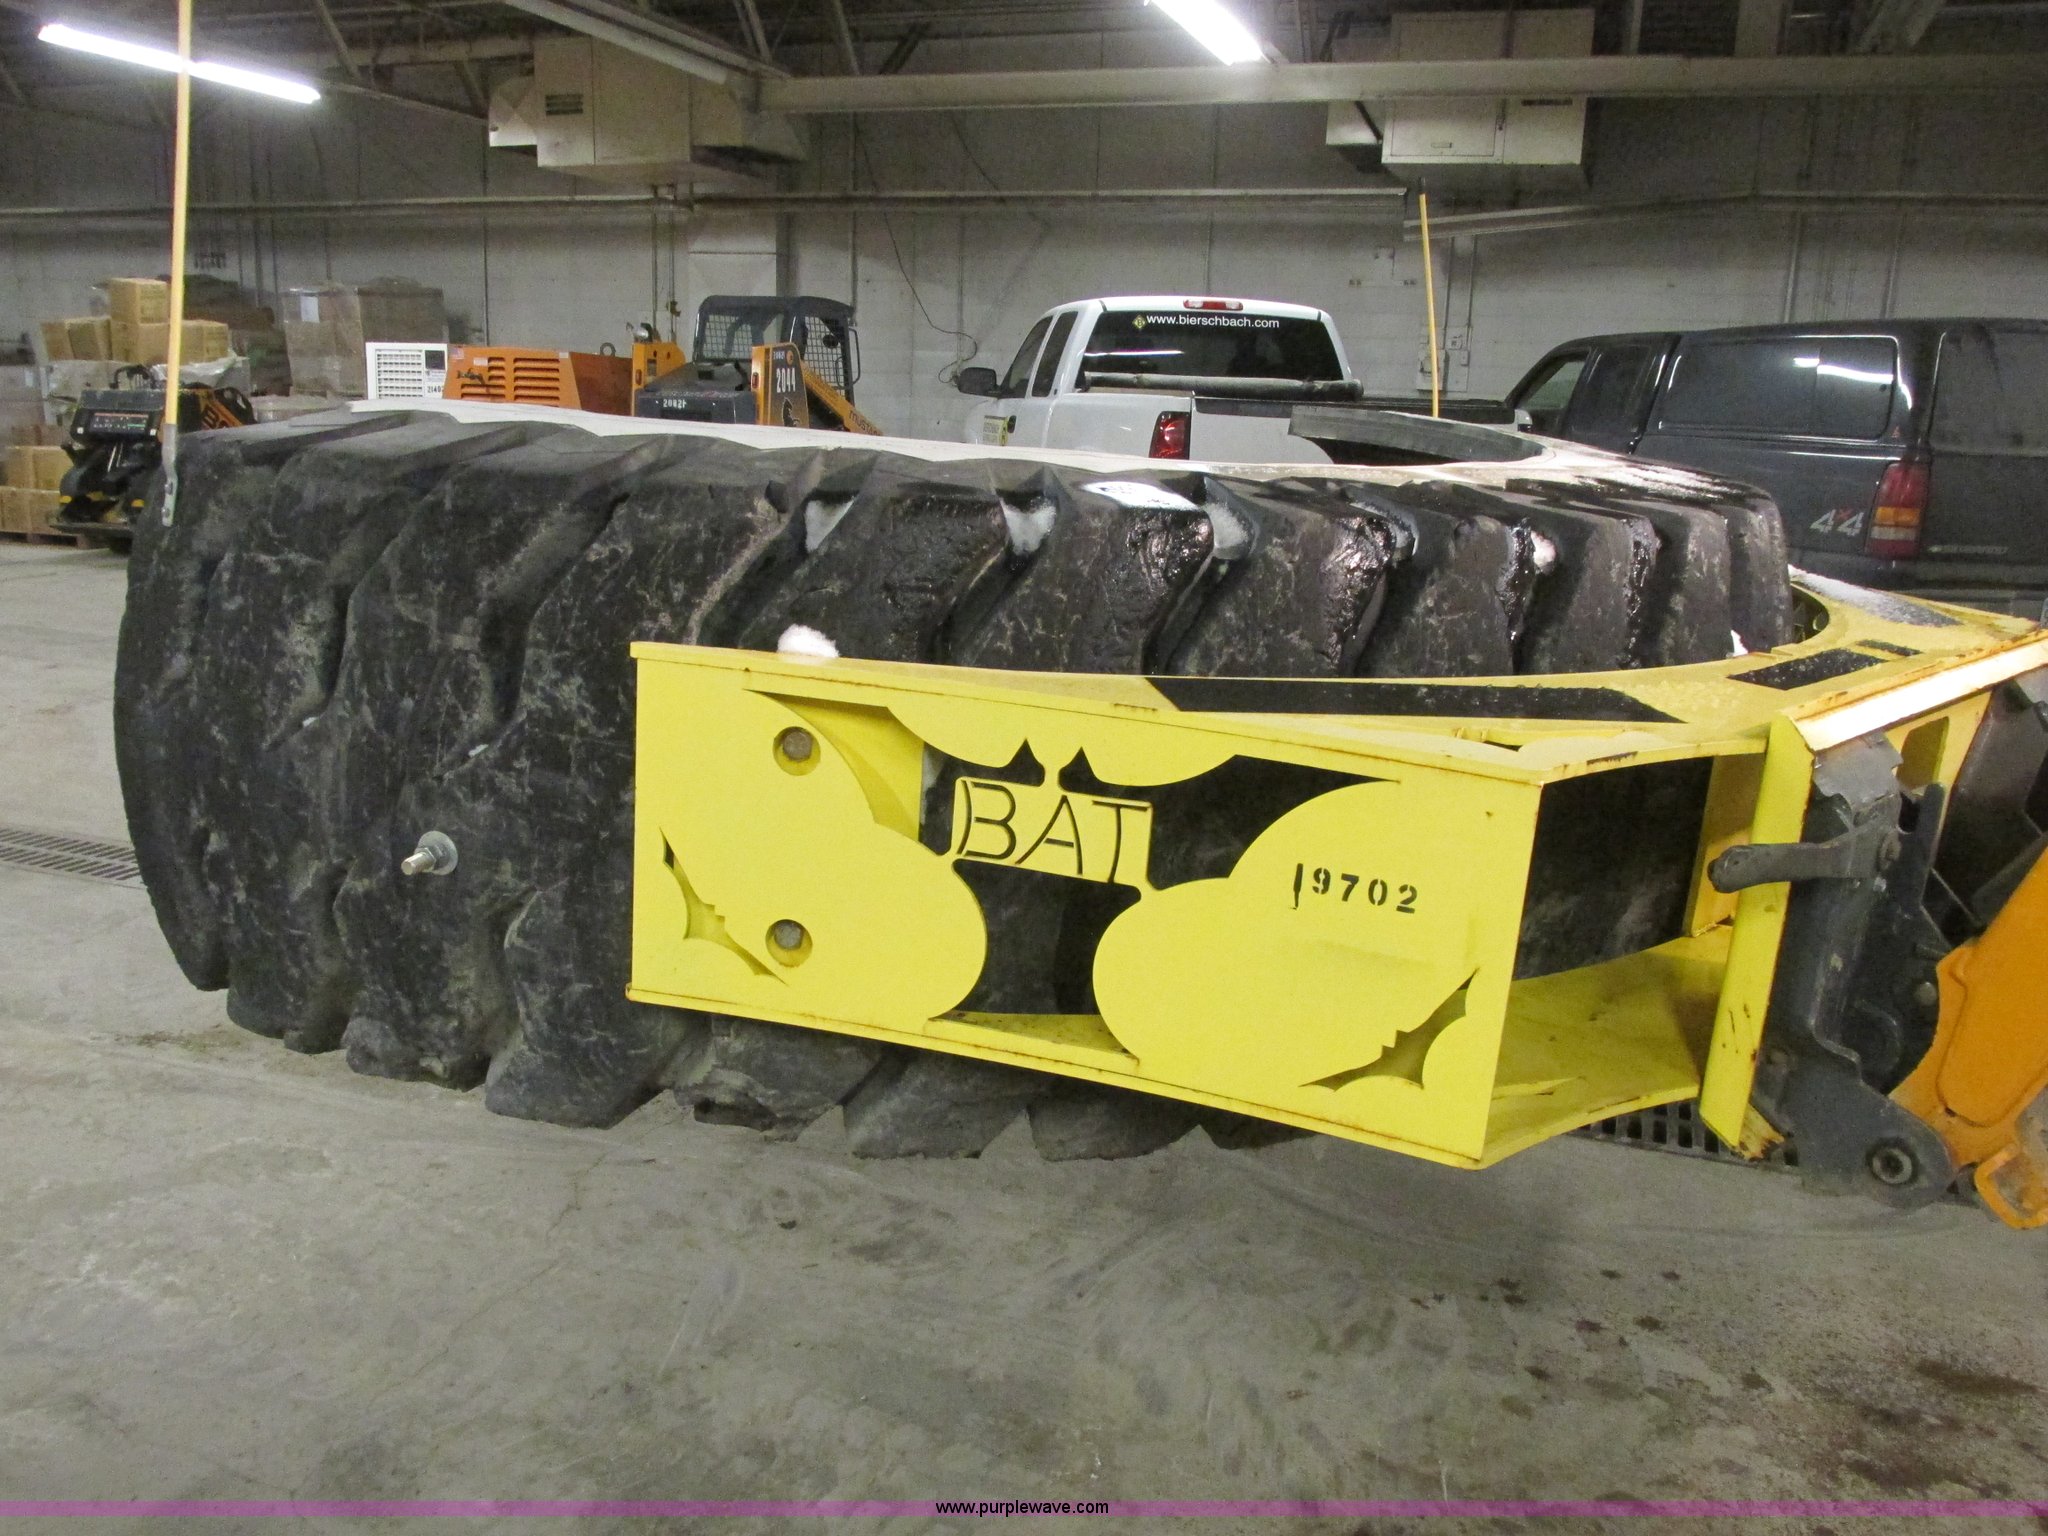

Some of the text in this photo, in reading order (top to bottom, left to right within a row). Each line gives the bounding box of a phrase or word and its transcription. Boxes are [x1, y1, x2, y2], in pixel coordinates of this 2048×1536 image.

[1146, 314, 1280, 328] www.bierschbach.com
[776, 367, 796, 393] 2044
[956, 779, 1149, 883] BAT
[1290, 862, 1418, 914] 19702
